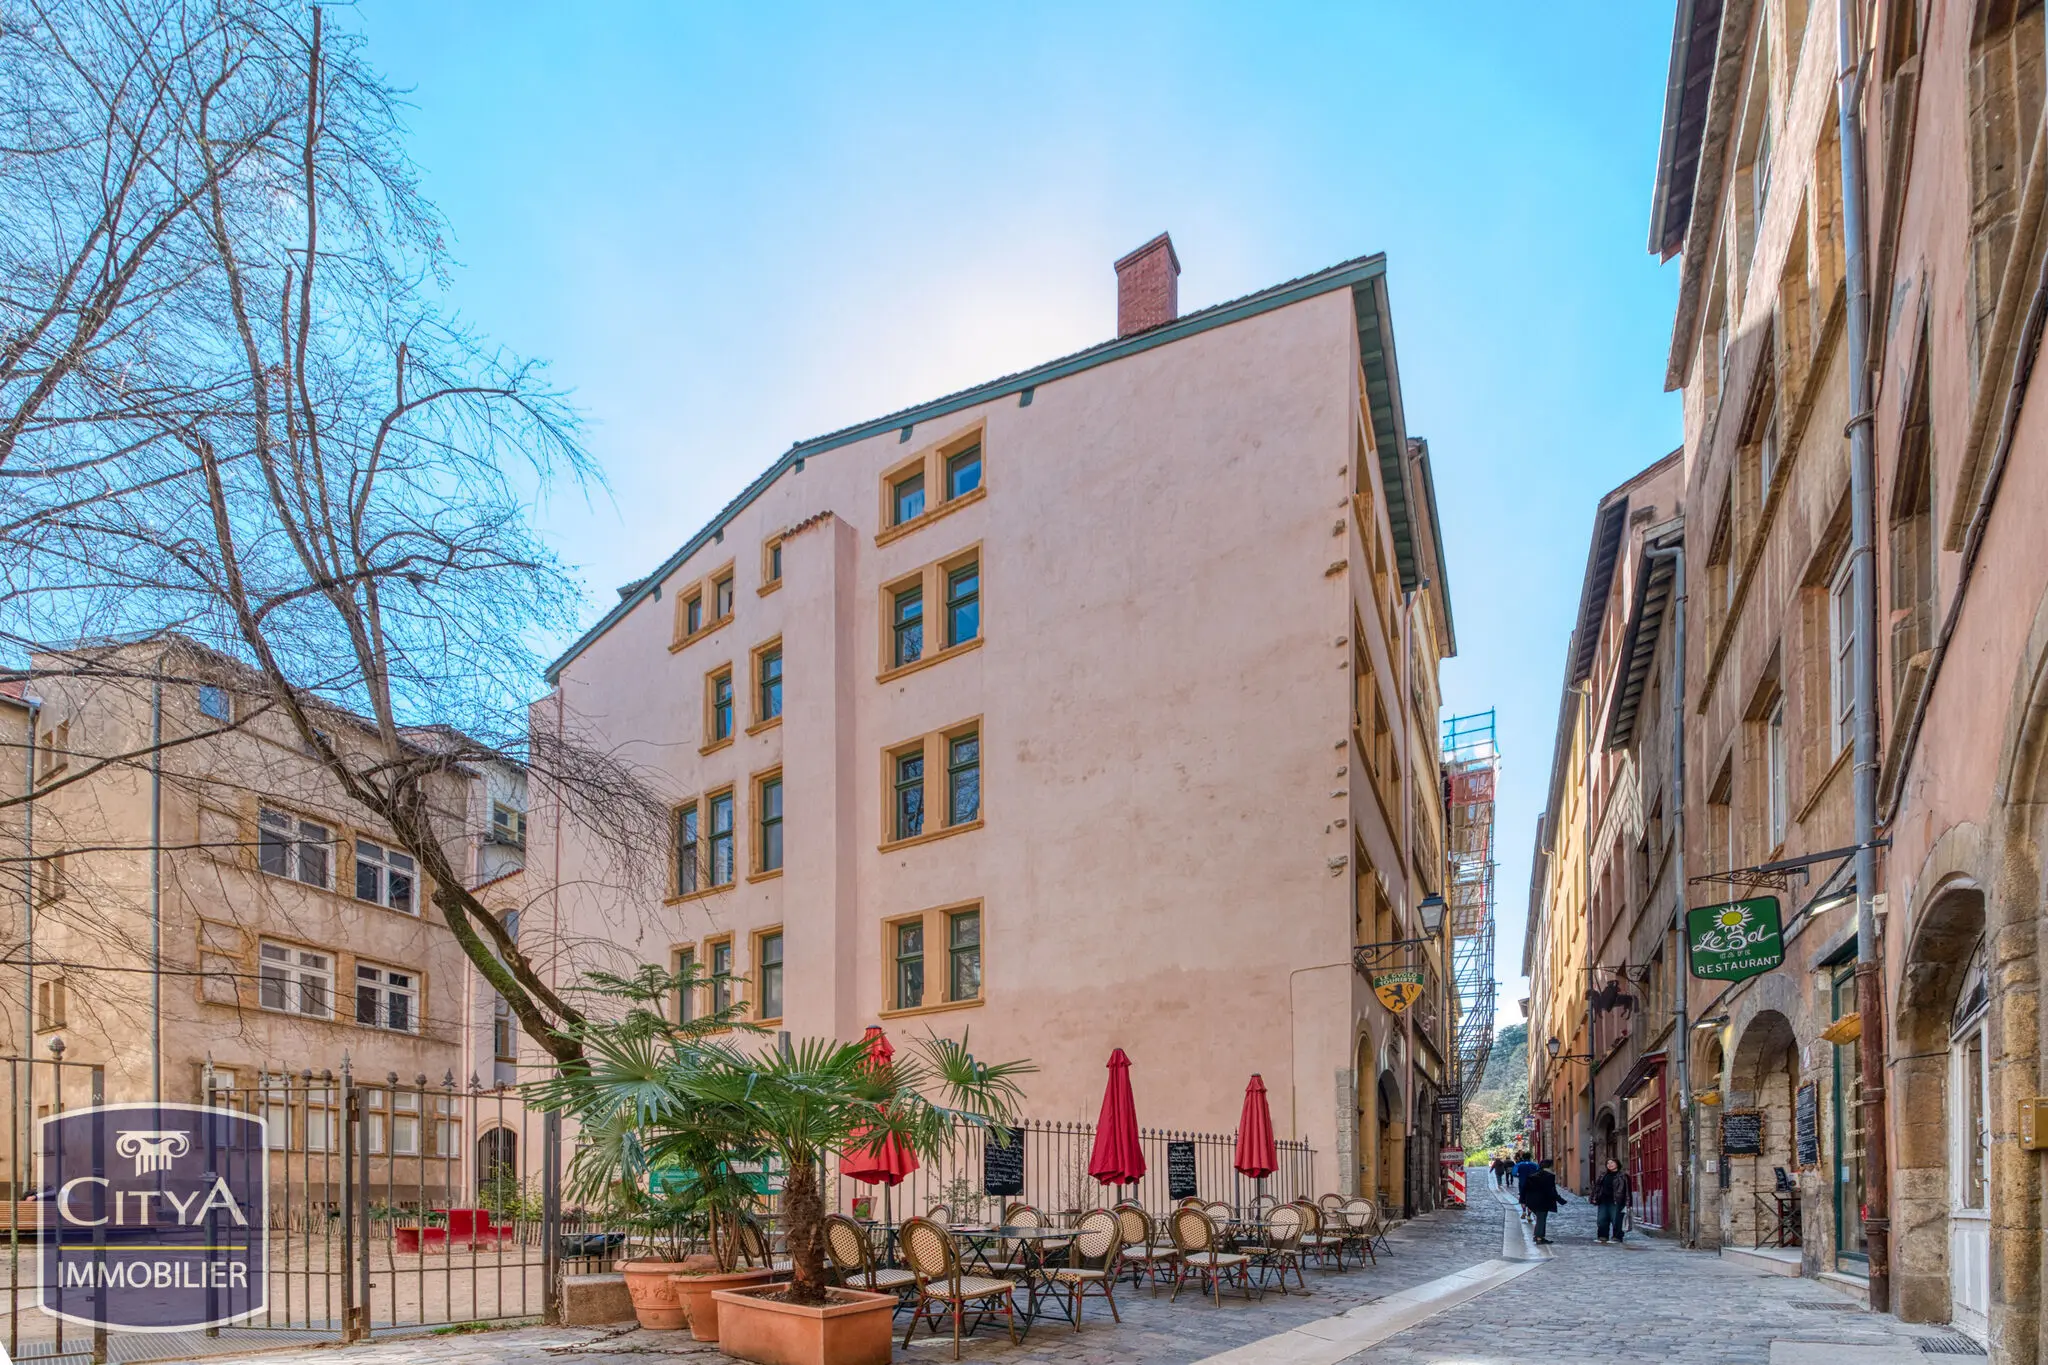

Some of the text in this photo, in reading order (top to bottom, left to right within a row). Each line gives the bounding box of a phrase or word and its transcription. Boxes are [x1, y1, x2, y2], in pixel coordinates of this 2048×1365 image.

[1692, 924, 1778, 952] Le Sol
[1698, 955, 1780, 974] RESTAURANT
[1379, 977, 1417, 985] TOURISTE
